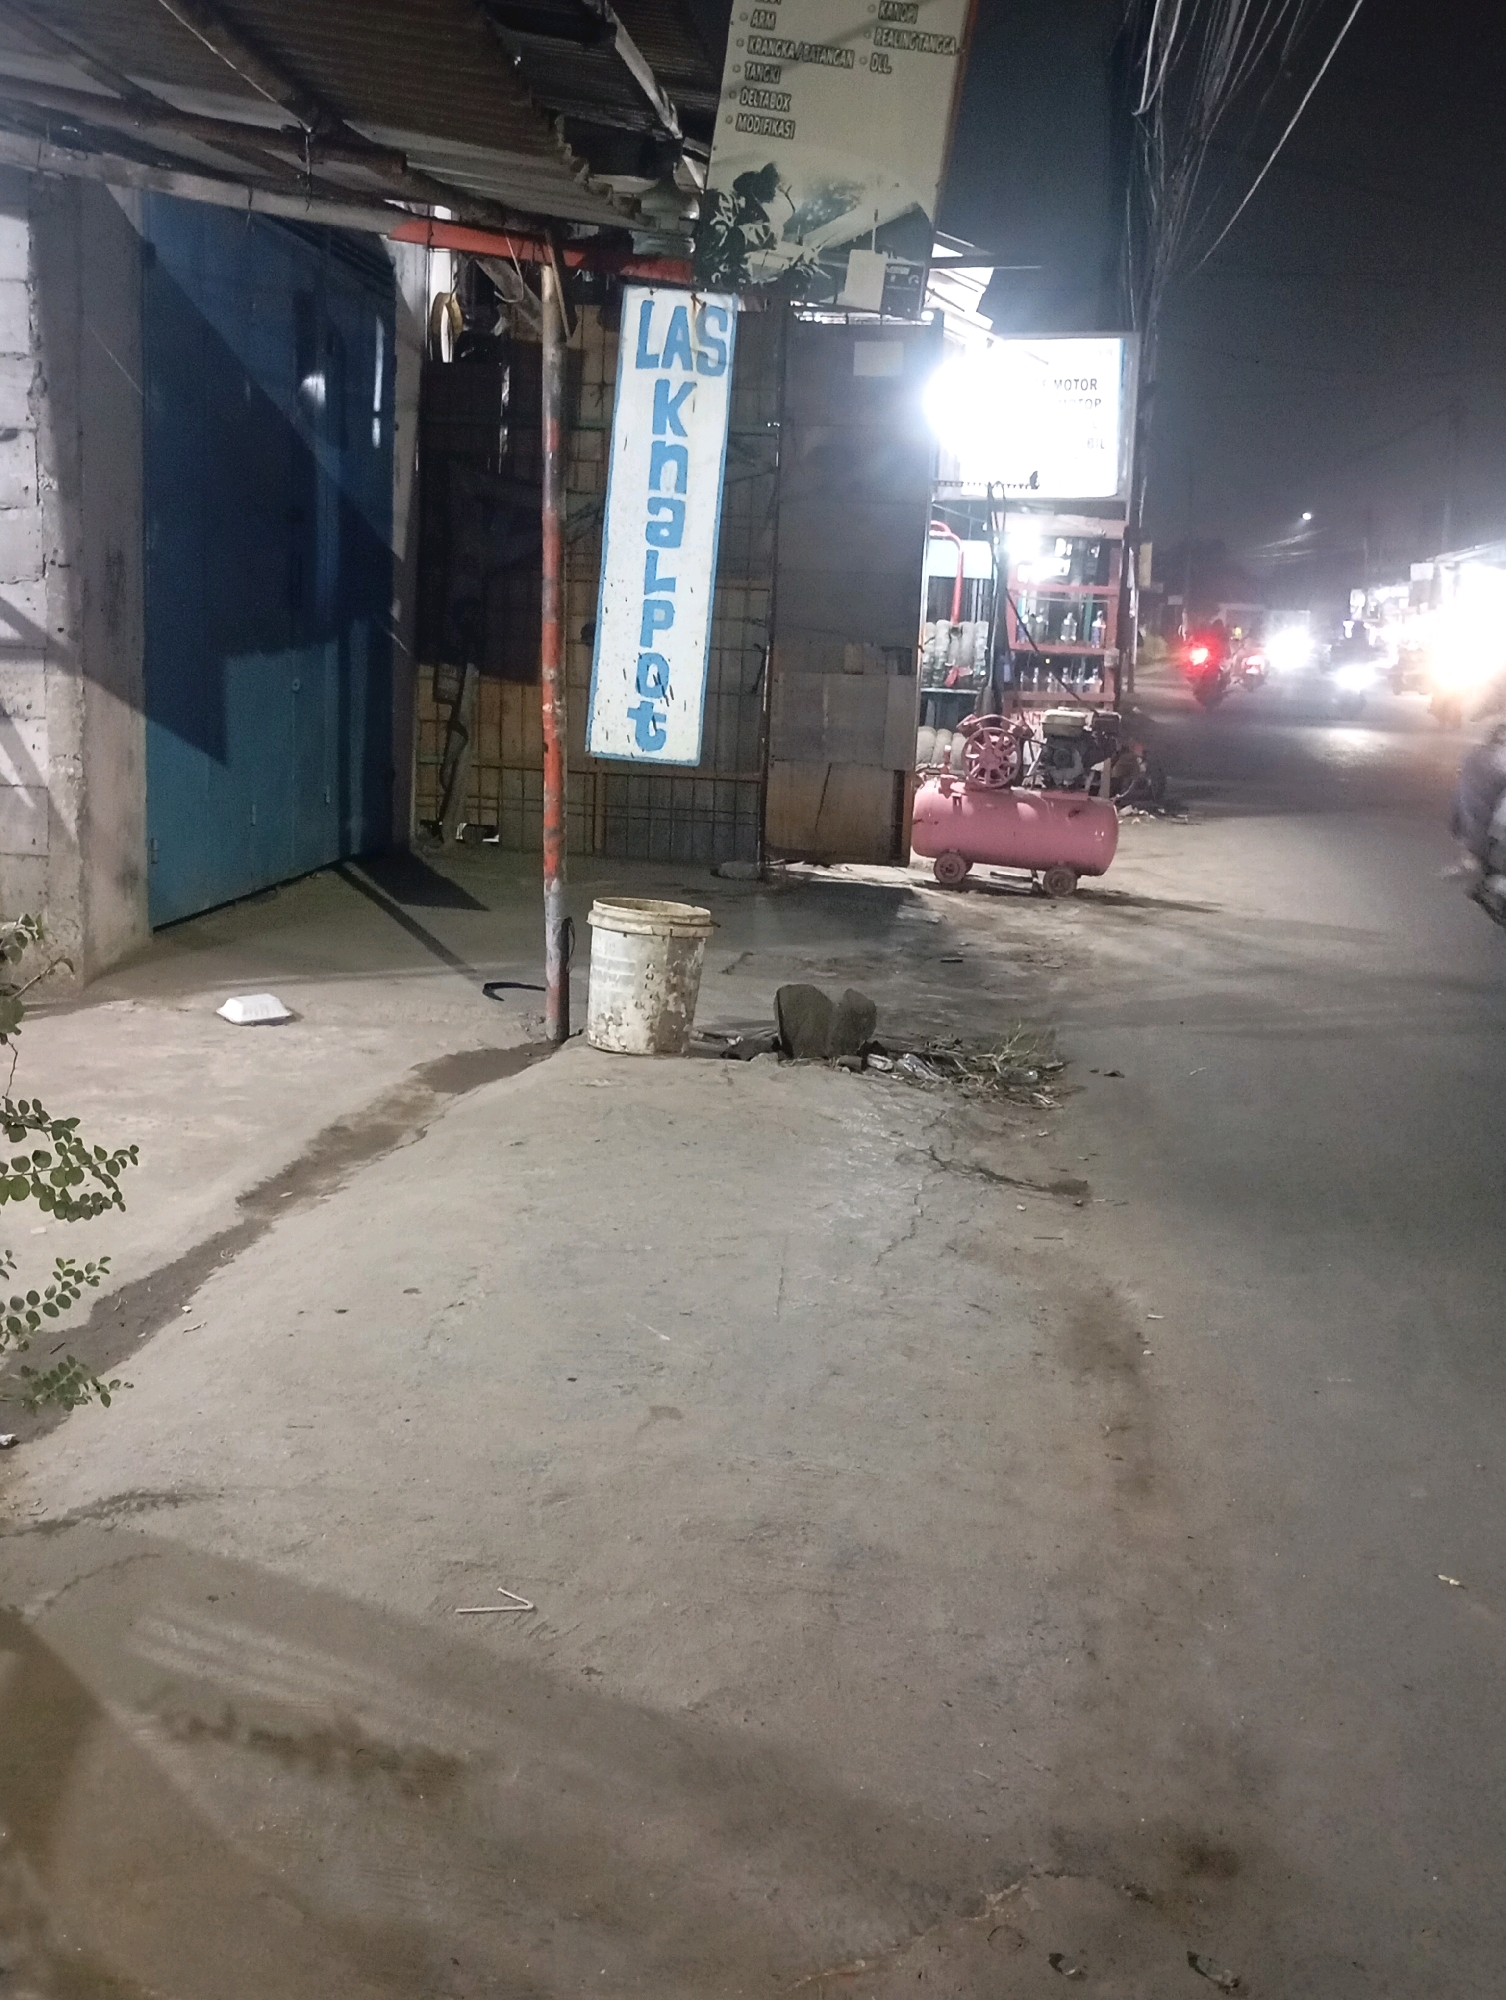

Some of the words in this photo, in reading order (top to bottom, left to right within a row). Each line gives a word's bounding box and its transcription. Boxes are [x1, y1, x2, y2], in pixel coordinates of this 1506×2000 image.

[750, 8, 776, 30] ARM
[745, 61, 781, 84] TANGKI
[740, 86, 792, 112] DELTABOX
[735, 113, 796, 140] MODIFIKASI
[635, 300, 728, 378] LAS
[1054, 378, 1098, 391] MOTOR
